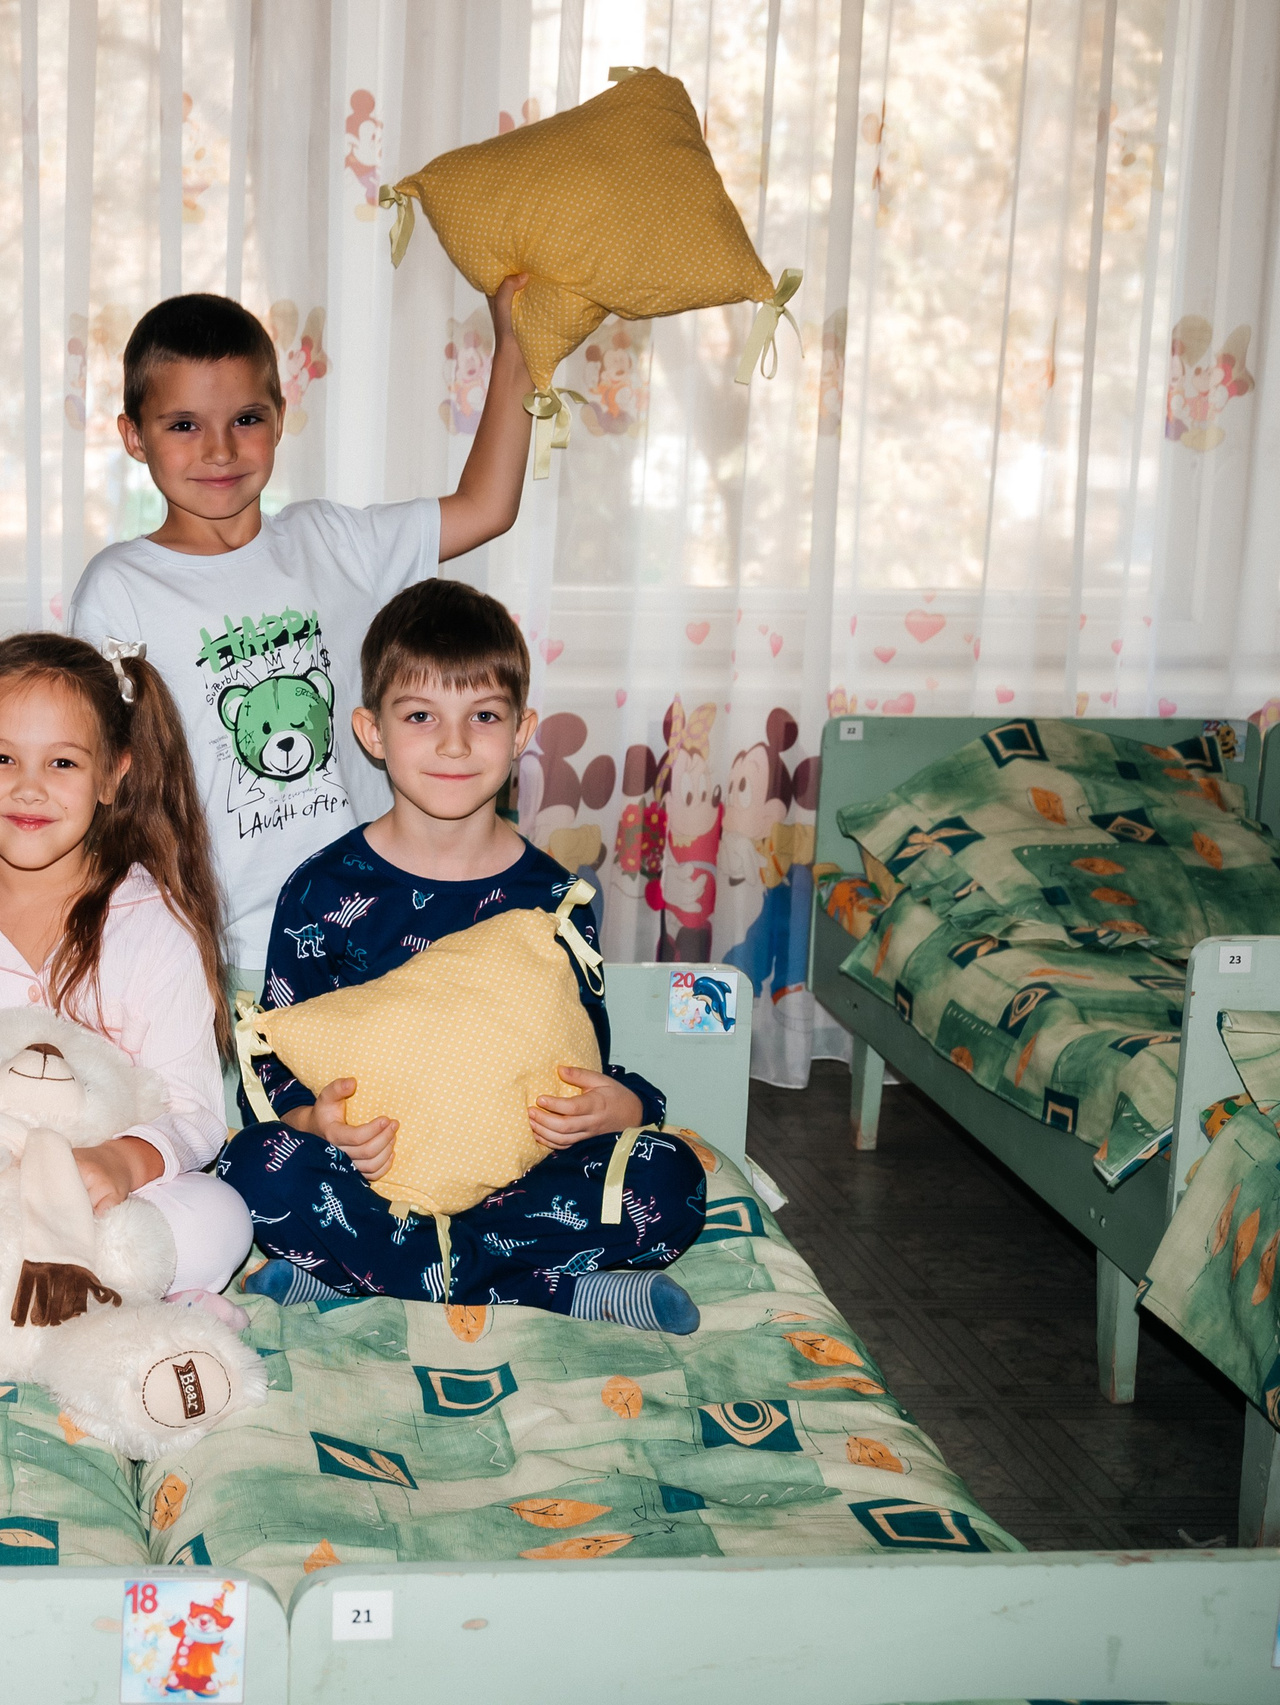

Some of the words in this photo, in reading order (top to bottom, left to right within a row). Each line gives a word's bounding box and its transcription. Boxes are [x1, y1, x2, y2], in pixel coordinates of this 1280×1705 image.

[1204, 720, 1220, 731] 22
[1229, 955, 1242, 965] 23
[672, 972, 695, 988] 20
[179, 1371, 199, 1411] Bear
[125, 1583, 158, 1614] 18
[351, 1608, 373, 1624] 21
